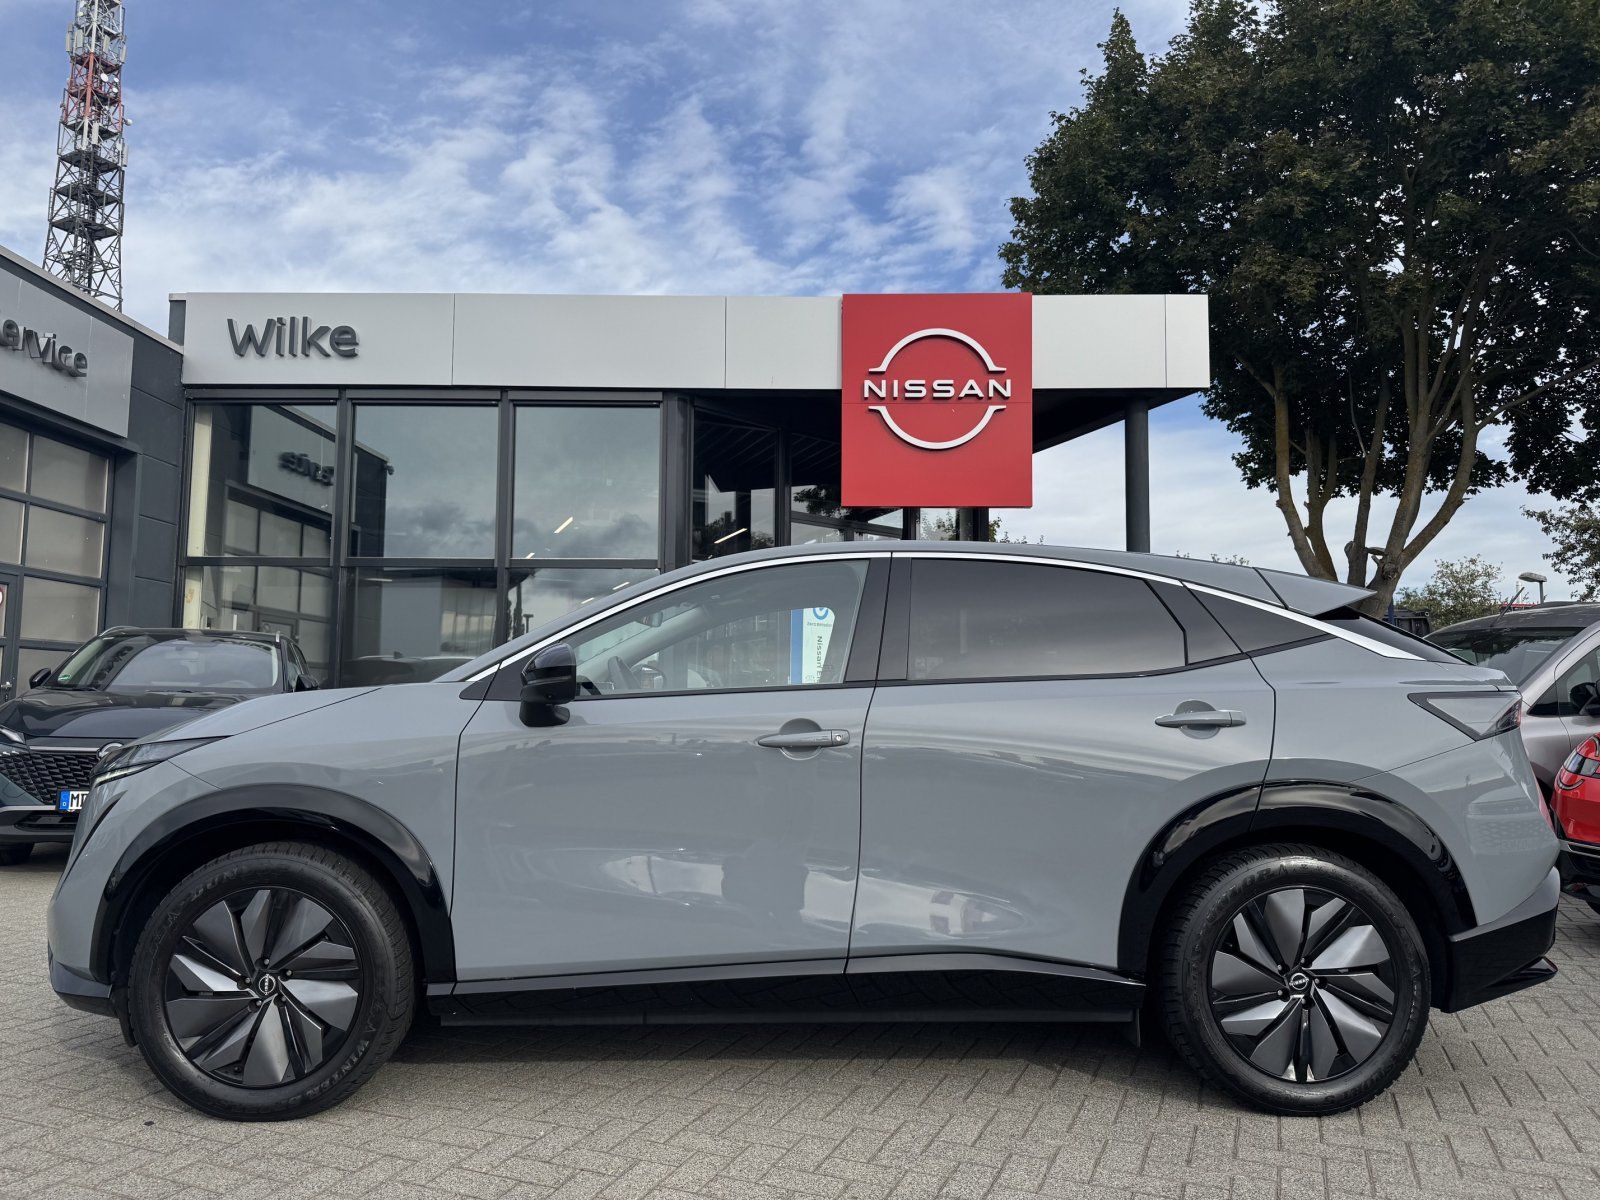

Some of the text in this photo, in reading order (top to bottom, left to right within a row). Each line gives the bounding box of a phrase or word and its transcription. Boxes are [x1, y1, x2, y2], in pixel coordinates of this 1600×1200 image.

[1, 319, 87, 378] ervice
[227, 316, 359, 358] Wilke
[863, 379, 1012, 398] NISSAN
